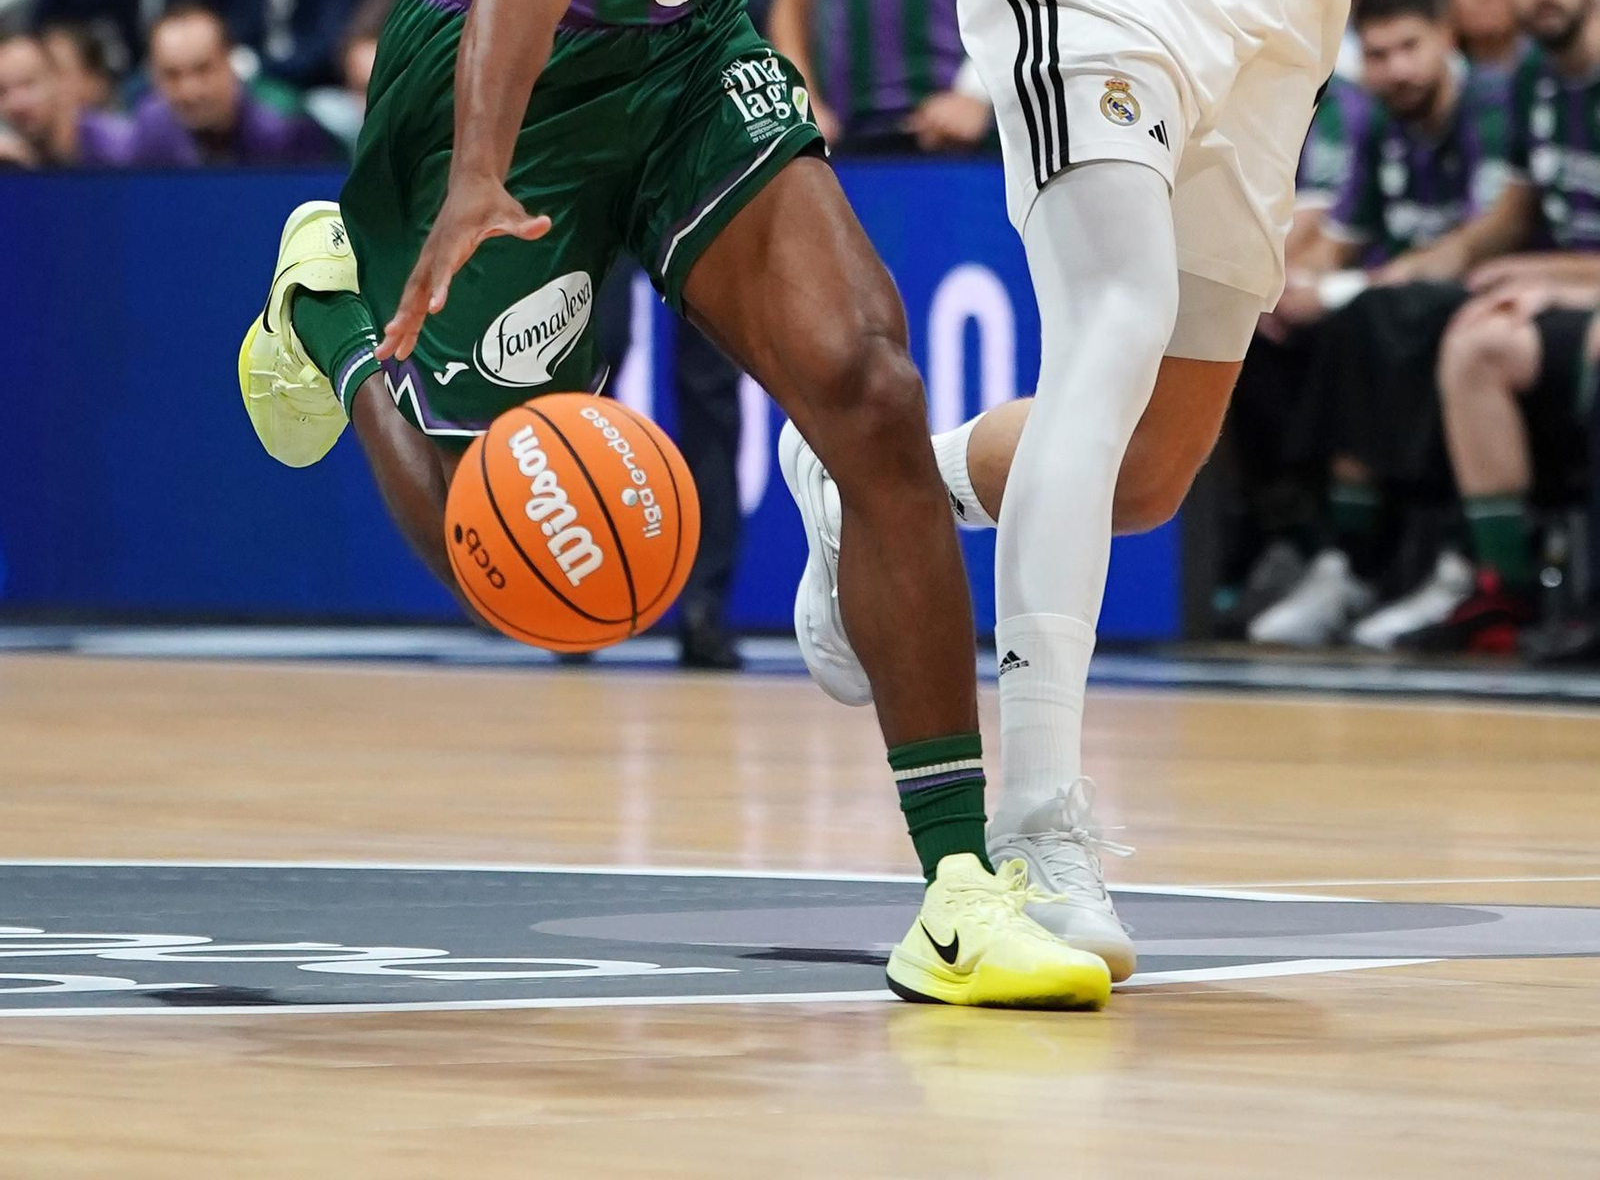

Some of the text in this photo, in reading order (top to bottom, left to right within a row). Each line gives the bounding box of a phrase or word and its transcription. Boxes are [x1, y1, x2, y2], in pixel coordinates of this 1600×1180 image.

[494, 282, 591, 374] famadesa
[507, 424, 604, 588] Wilson
[637, 487, 663, 539] liga
[464, 526, 507, 590] acb
